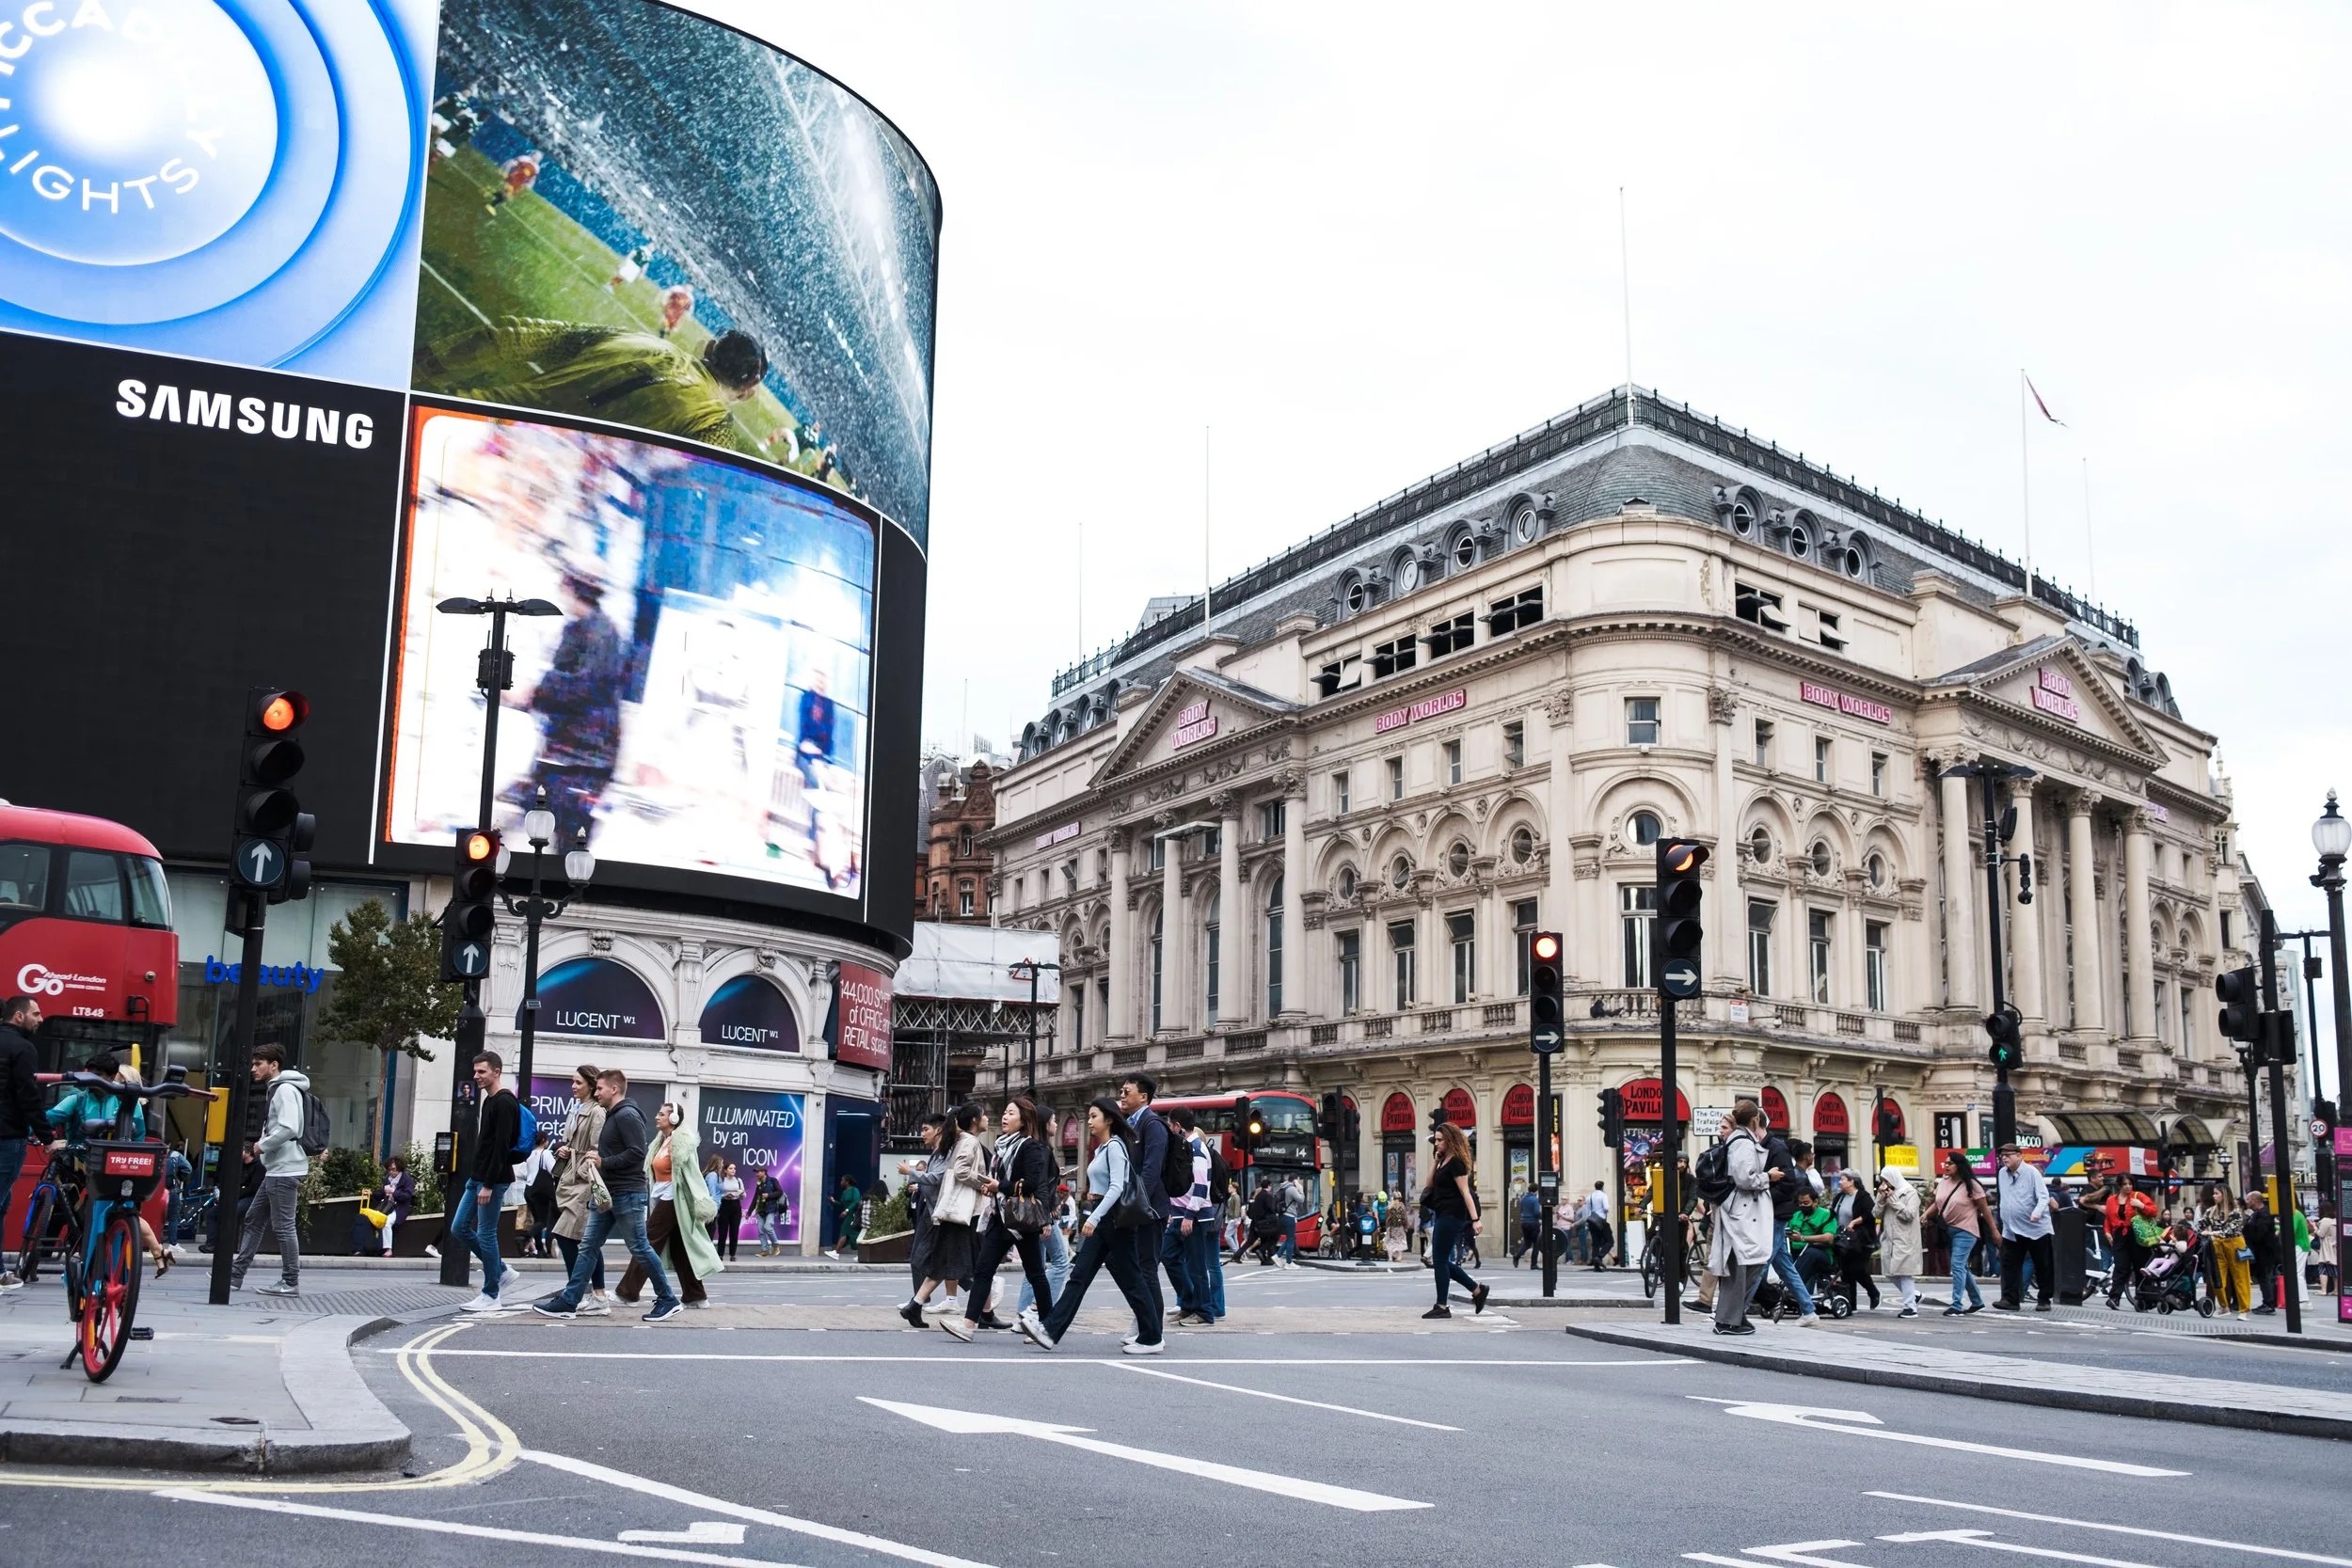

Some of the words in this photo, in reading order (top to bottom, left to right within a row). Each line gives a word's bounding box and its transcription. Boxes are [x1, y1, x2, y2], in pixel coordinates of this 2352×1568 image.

[116, 378, 373, 450] SAMSUNG
[2042, 669, 2072, 696] BODY
[1375, 707, 1409, 732] BODY
[1411, 689, 1464, 721] WORLDS
[1804, 684, 1839, 708] BODY
[1841, 695, 1890, 722] WORLDS
[2033, 688, 2079, 721] WORLDS
[1178, 700, 1209, 728] BODY
[1171, 717, 1216, 749] WORLDS
[17, 963, 64, 995] Go
[840, 979, 875, 1006] 144,000
[72, 1006, 104, 1018] LT848
[556, 1010, 620, 1030] LUCENT
[623, 1016, 636, 1024] W1
[850, 1006, 858, 1024] of
[860, 1006, 882, 1033] OFFICE
[722, 1024, 768, 1043] LUCENT
[770, 1030, 779, 1038] W1
[843, 1025, 870, 1051] RETAIL
[1630, 1085, 1662, 1099] LONDO
[531, 1096, 580, 1116] PRIM
[1448, 1097, 1469, 1107] LONDON
[1624, 1098, 1662, 1117] PAVILI
[1761, 1097, 1779, 1107] ONDON
[1820, 1101, 1840, 1111] LONDON
[706, 1106, 795, 1128] ILLUMINATED
[1387, 1112, 1412, 1127] PAVILION
[1448, 1109, 1472, 1121] AVILION
[1508, 1104, 1534, 1120] PAVILIO
[1818, 1112, 1844, 1127] PAVILION
[536, 1119, 566, 1136] reta
[2312, 1124, 2326, 1132] 20
[713, 1127, 730, 1148] by
[732, 1132, 749, 1146] an
[2015, 1135, 2042, 1148] BACCO
[742, 1148, 777, 1166] ICON
[1295, 1147, 1307, 1158] 14
